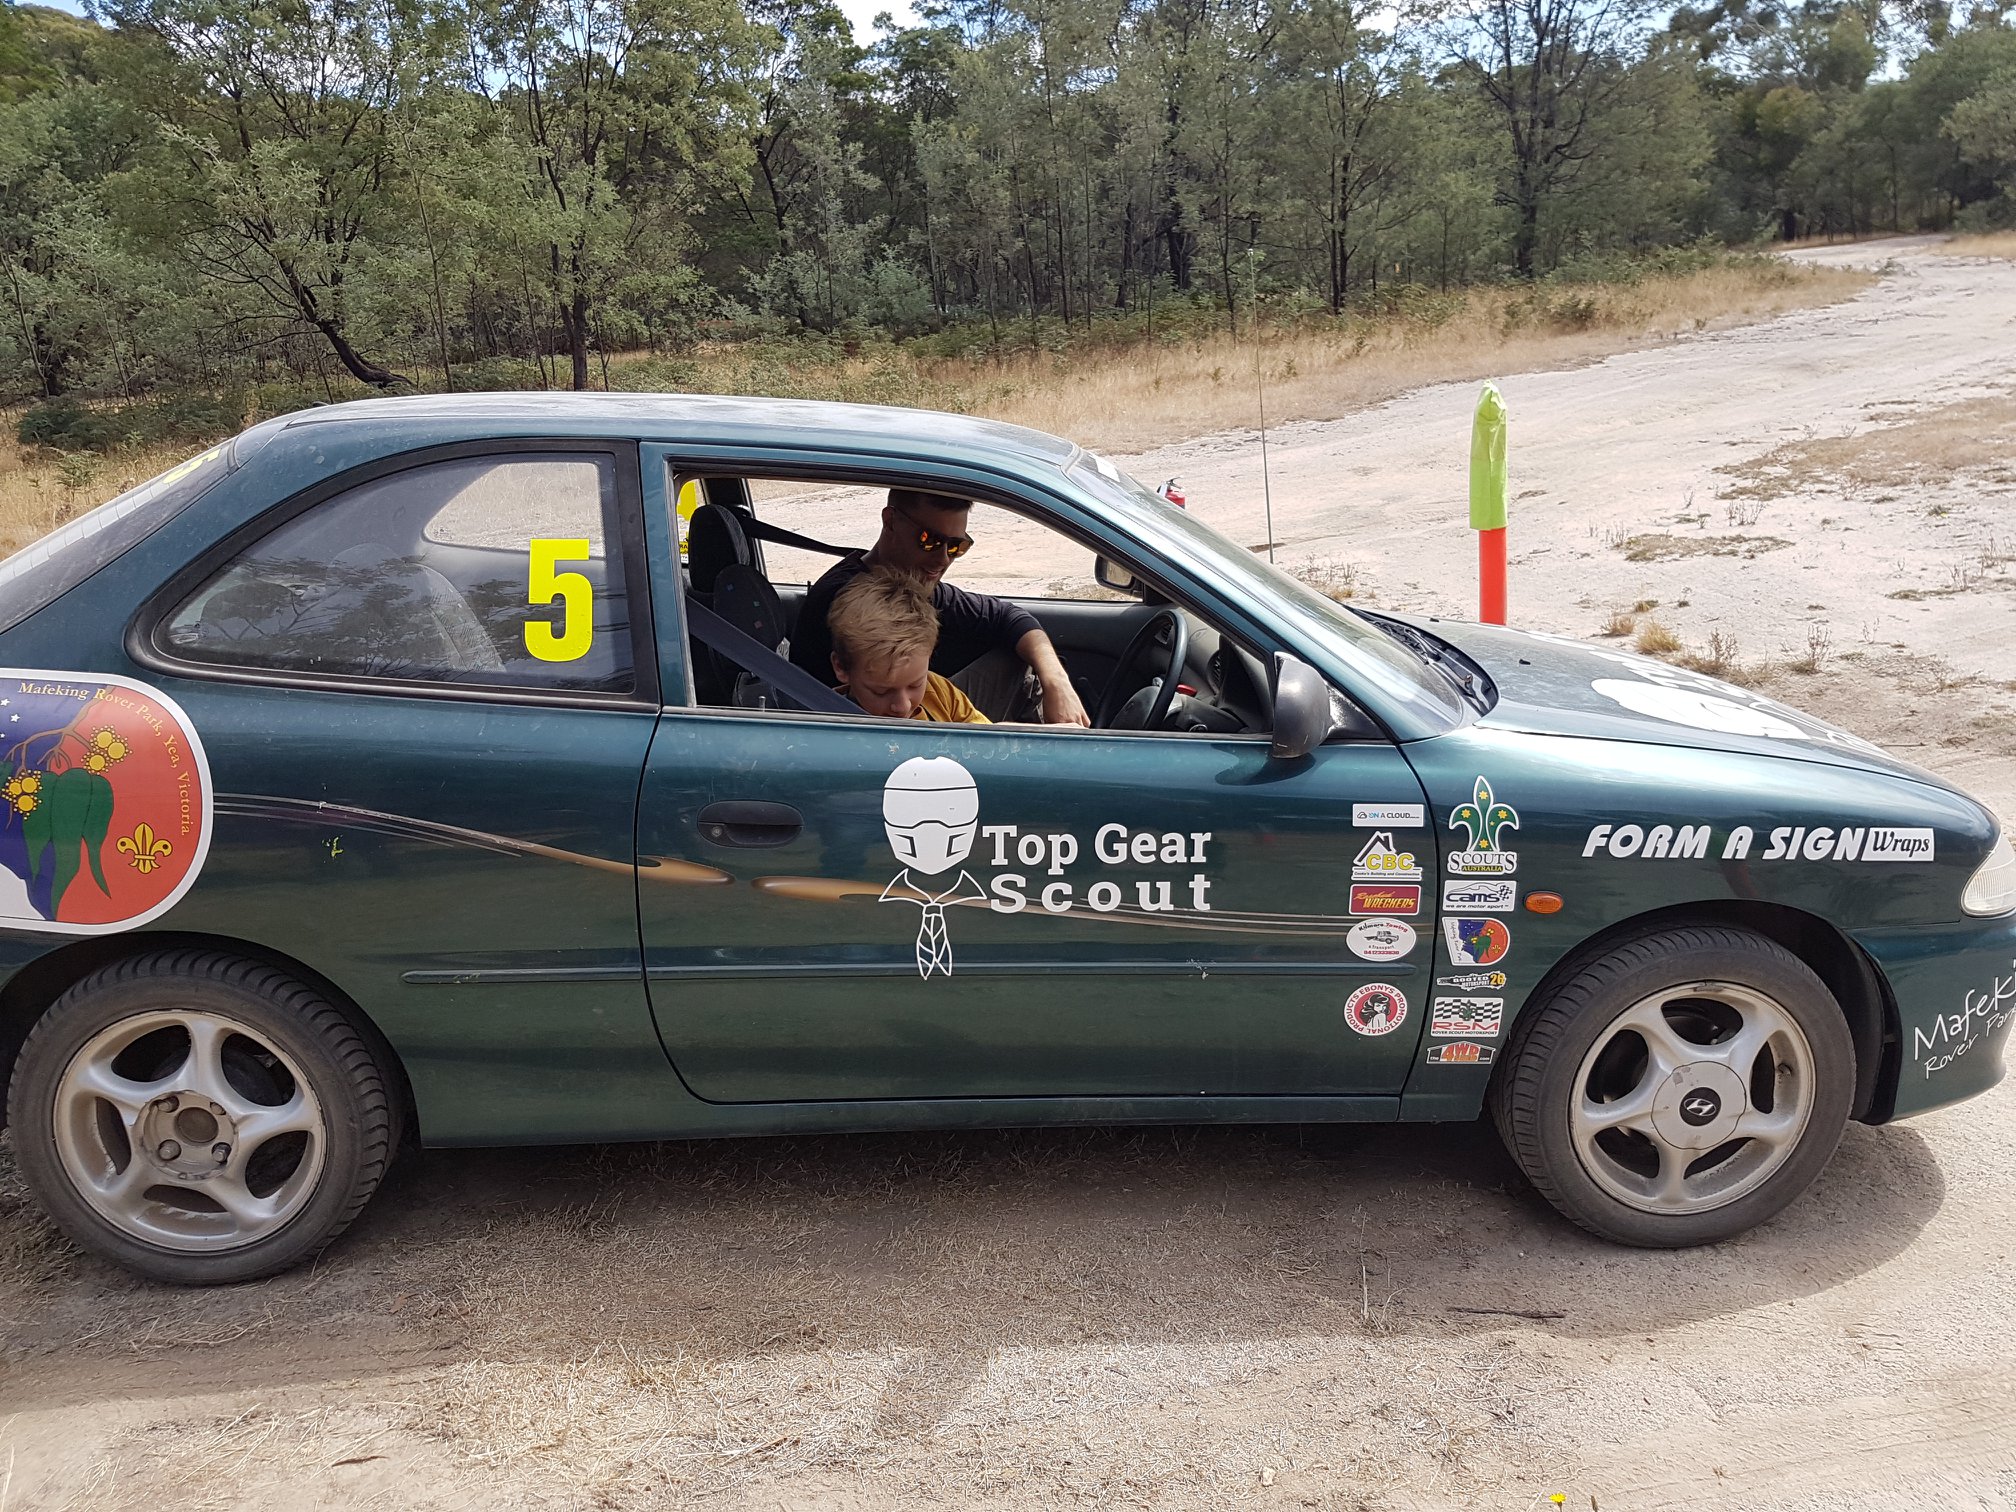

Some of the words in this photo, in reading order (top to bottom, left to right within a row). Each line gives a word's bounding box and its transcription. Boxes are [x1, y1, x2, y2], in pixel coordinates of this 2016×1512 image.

[525, 538, 593, 662] 5
[18, 682, 90, 700] Mafeking
[93, 688, 136, 710] Rover
[136, 704, 165, 737] Park,
[162, 734, 180, 768] Yea,
[177, 771, 194, 836] Victoria
[982, 825, 1079, 876] Top
[1094, 823, 1212, 865] Gear
[1582, 824, 1712, 859] FORM
[1721, 825, 1754, 860] A
[1761, 826, 1866, 861] SIGN
[1872, 830, 1930, 858] Wraps
[1366, 853, 1413, 871] CBC
[1450, 852, 1515, 871] SCOUTS
[990, 873, 1212, 914] Scout
[1363, 898, 1417, 909] WRECKERS
[1358, 922, 1384, 932] Kilmore
[1386, 922, 1408, 933] Towing
[1359, 984, 1395, 995] EBONYS
[1346, 993, 1364, 1032] PRODUCTS
[1433, 1021, 1499, 1031] RSM
[1924, 1033, 1979, 1079] Rover
